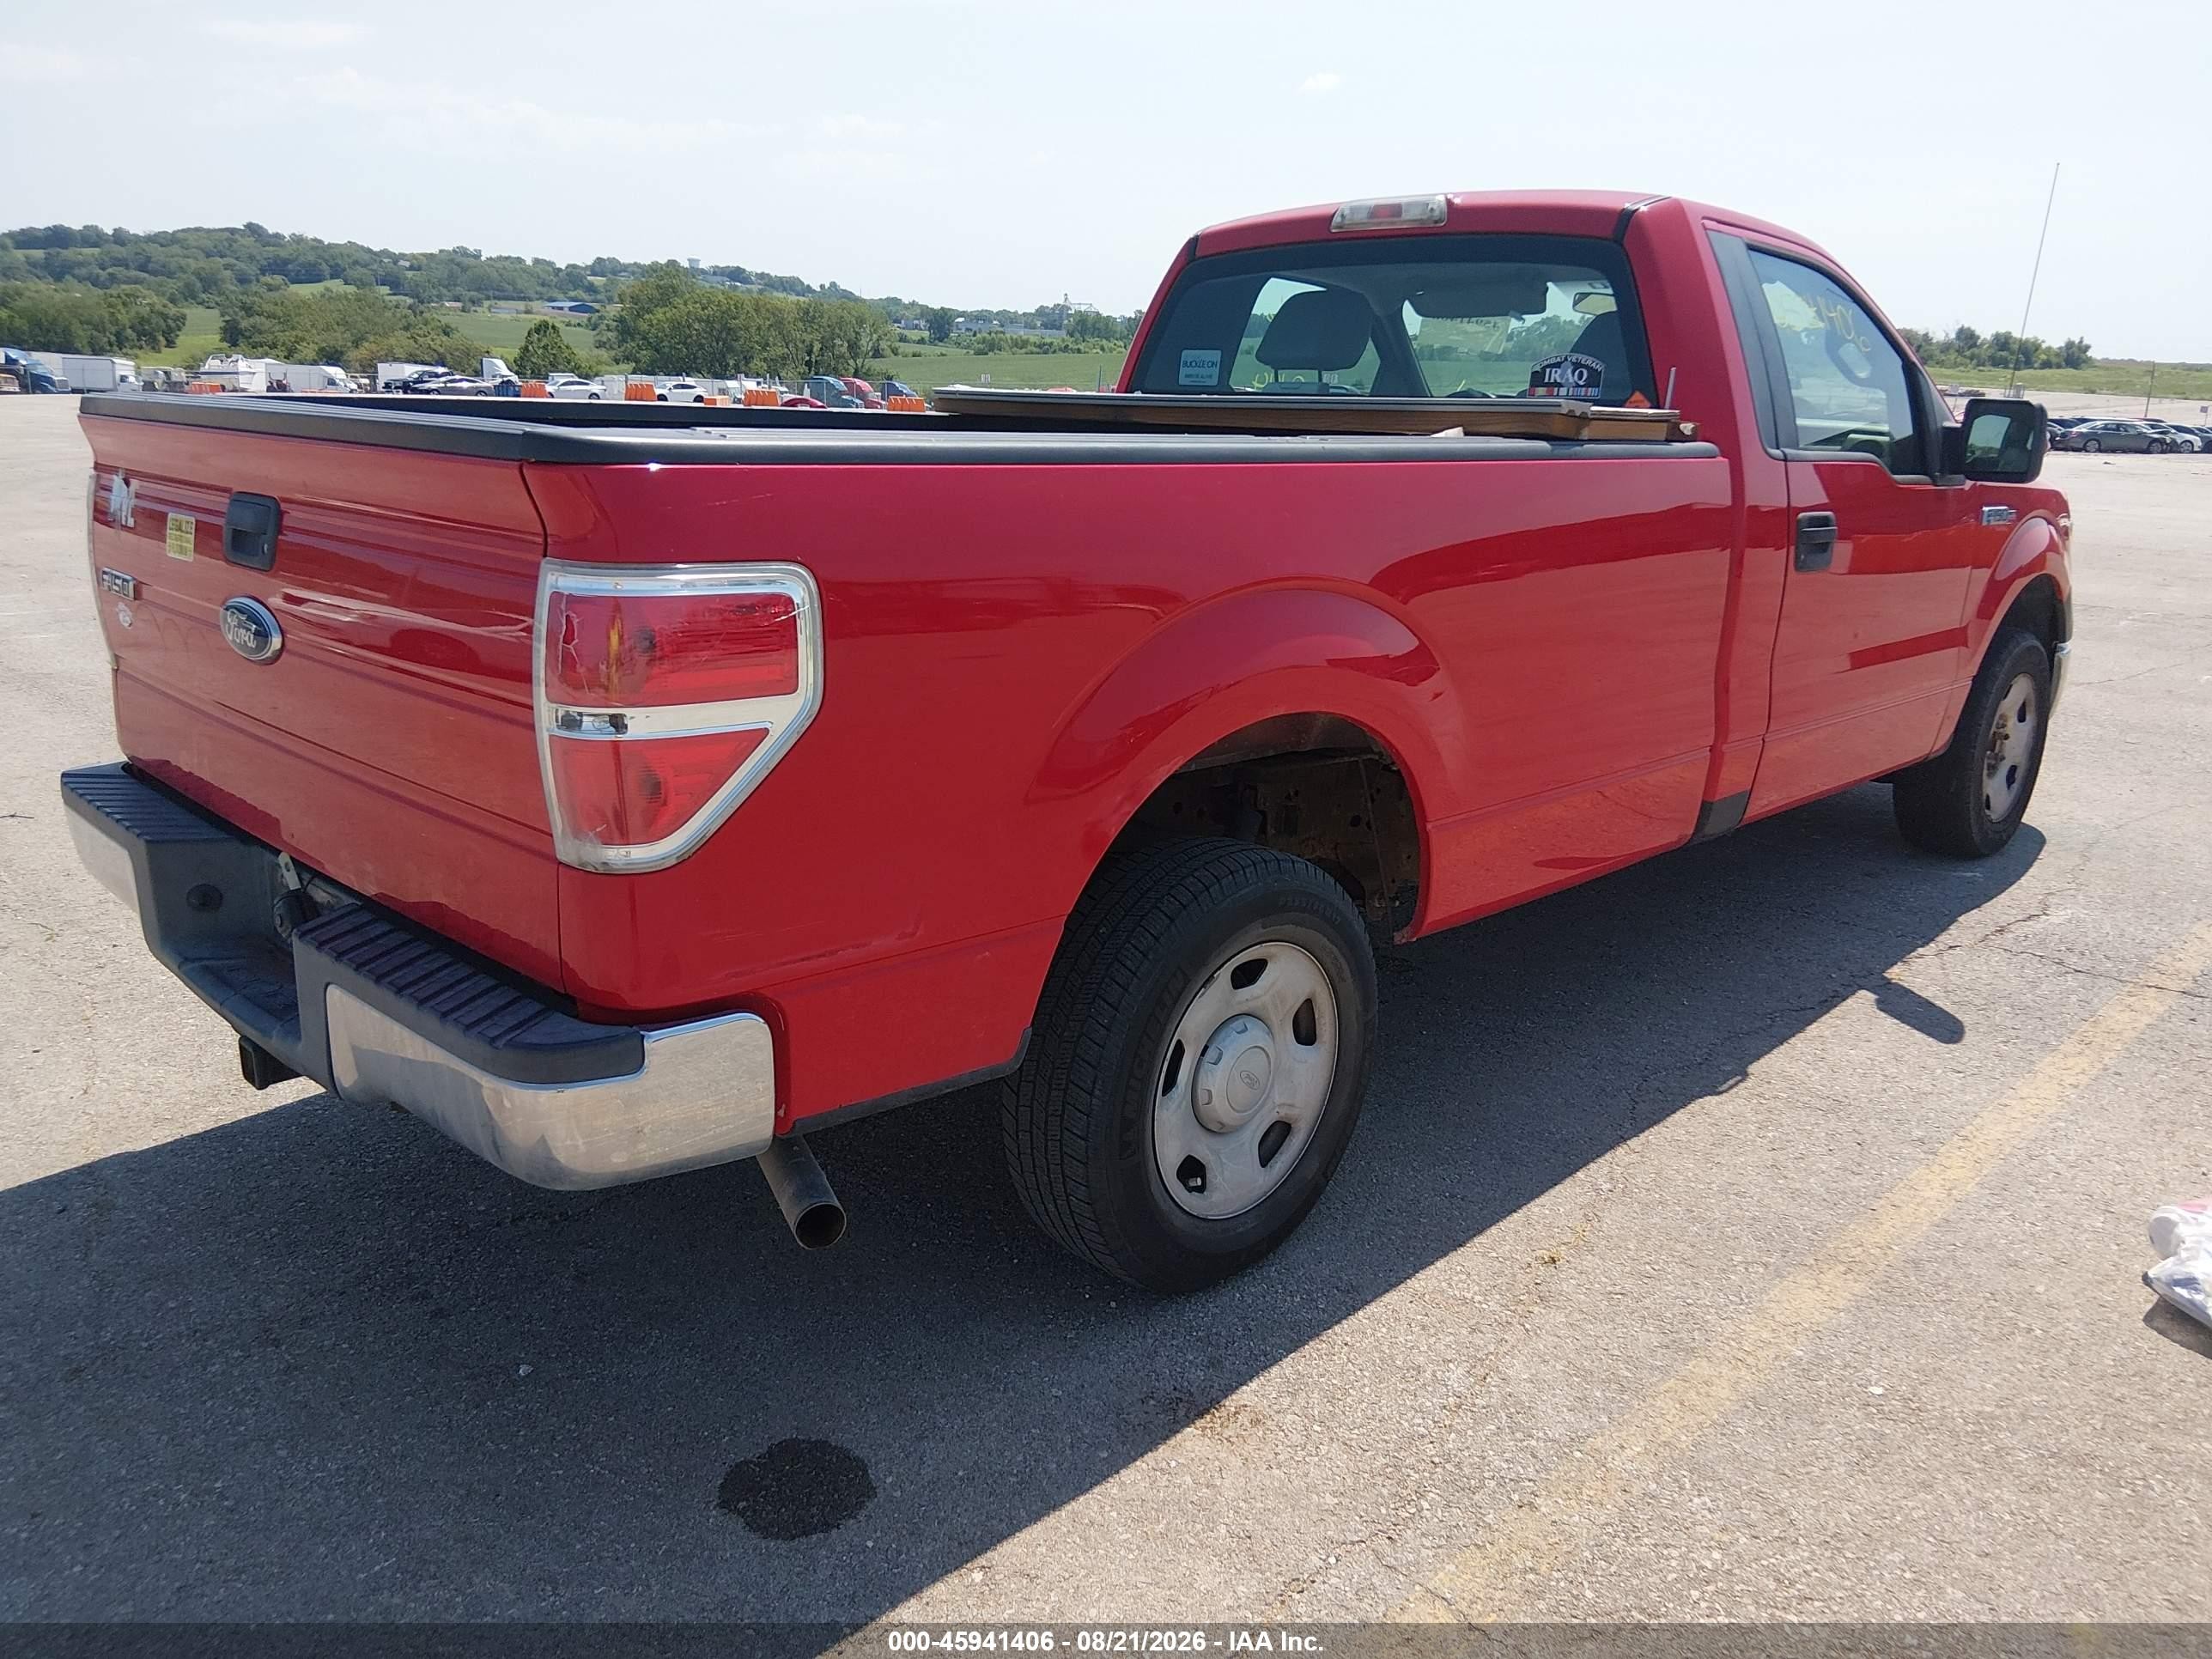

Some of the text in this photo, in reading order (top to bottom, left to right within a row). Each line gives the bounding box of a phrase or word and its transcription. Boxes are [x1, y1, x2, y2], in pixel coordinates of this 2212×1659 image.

[1544, 368, 1588, 385] IRAQ
[1566, 356, 1603, 372] VETERAN
[226, 608, 262, 648] Ford
[1122, 965, 1193, 1120] MICHELIN
